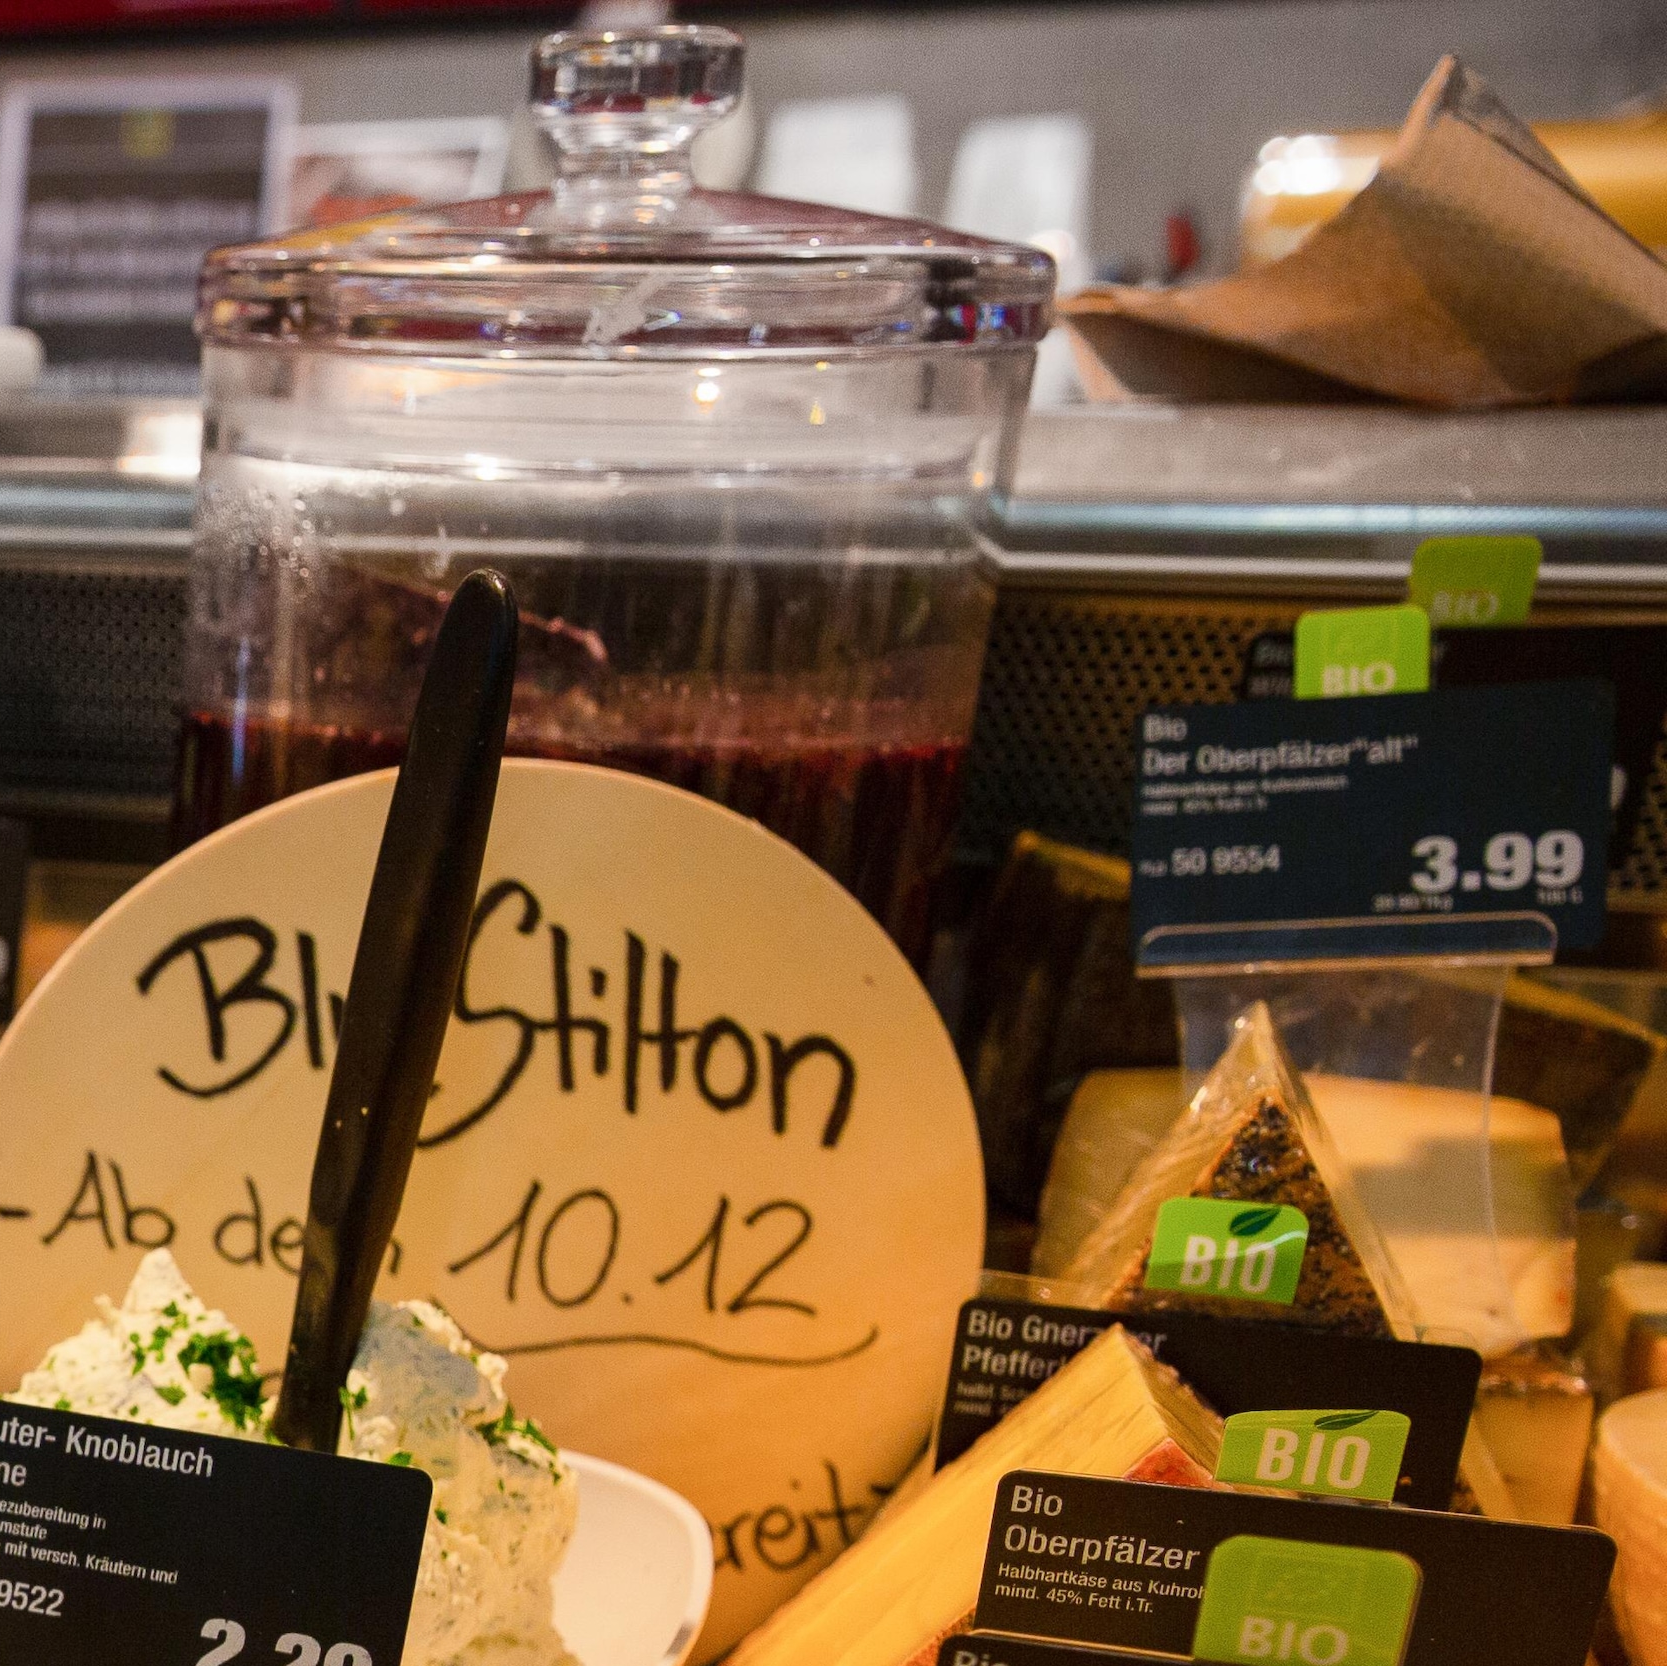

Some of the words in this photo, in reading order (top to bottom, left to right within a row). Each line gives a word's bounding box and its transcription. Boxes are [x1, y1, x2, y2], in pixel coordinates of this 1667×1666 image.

[1321, 661, 1397, 698] BIO
[1143, 714, 1187, 743] Bio
[1142, 747, 1189, 776] Der
[1173, 848, 1206, 875] 50
[1411, 829, 1585, 894] 3.99
[417, 878, 856, 1149] Stilton
[1179, 1235, 1276, 1295] BIO
[968, 1308, 1013, 1340] Bio
[65, 1424, 214, 1479] Knoblauch
[1254, 1427, 1373, 1491] BIO
[1009, 1485, 1064, 1518] Bio
[93, 1514, 107, 1530] in
[4, 1538, 27, 1559] mit
[31, 1544, 80, 1568] versch.
[85, 1553, 147, 1580] Kräutern
[149, 1565, 179, 1585] und
[1003, 1524, 1201, 1573] Oberpfälzer
[994, 1581, 1040, 1603] mind.
[1045, 1586, 1083, 1608] 45%
[1087, 1592, 1121, 1611] Fett
[997, 1563, 1108, 1591] Halbhartkäse
[1112, 1576, 1144, 1595] aus
